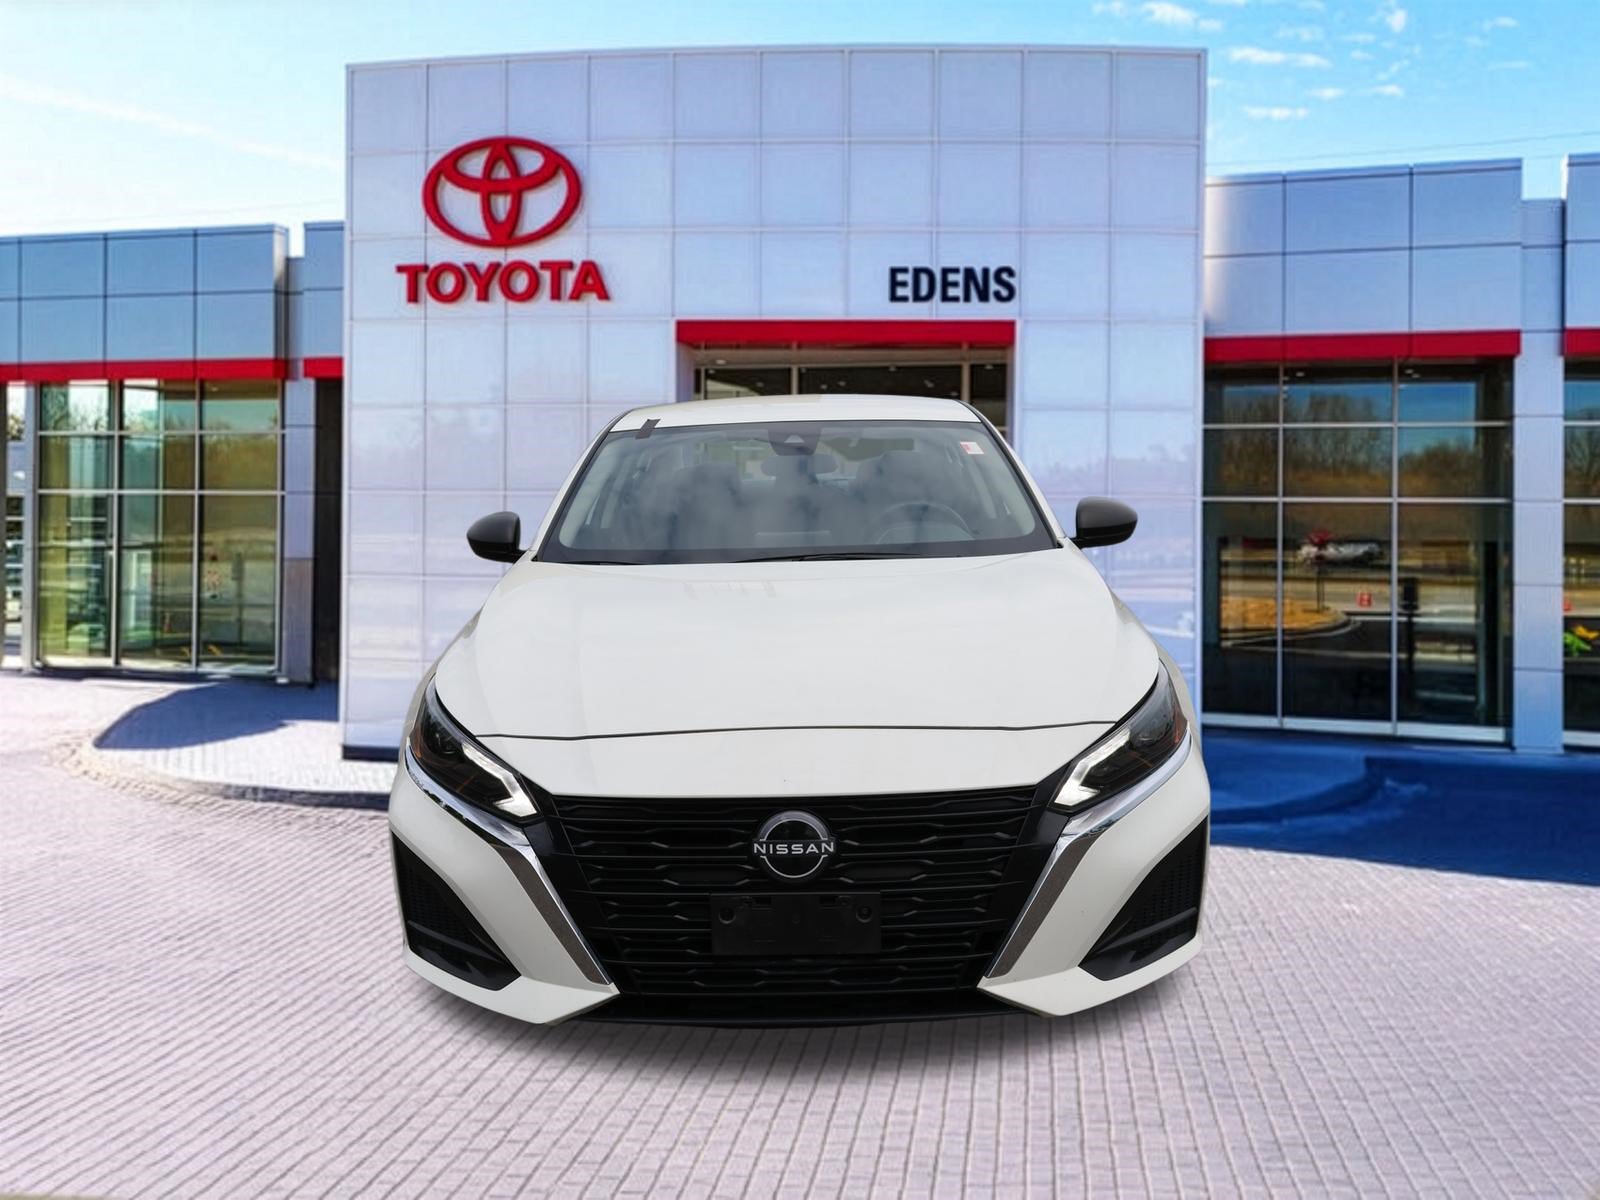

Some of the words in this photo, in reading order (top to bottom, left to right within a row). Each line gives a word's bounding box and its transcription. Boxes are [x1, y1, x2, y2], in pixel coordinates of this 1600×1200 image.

[397, 260, 609, 304] TOYOTA
[889, 266, 1017, 303] EDENS
[753, 841, 835, 855] NISSAN
